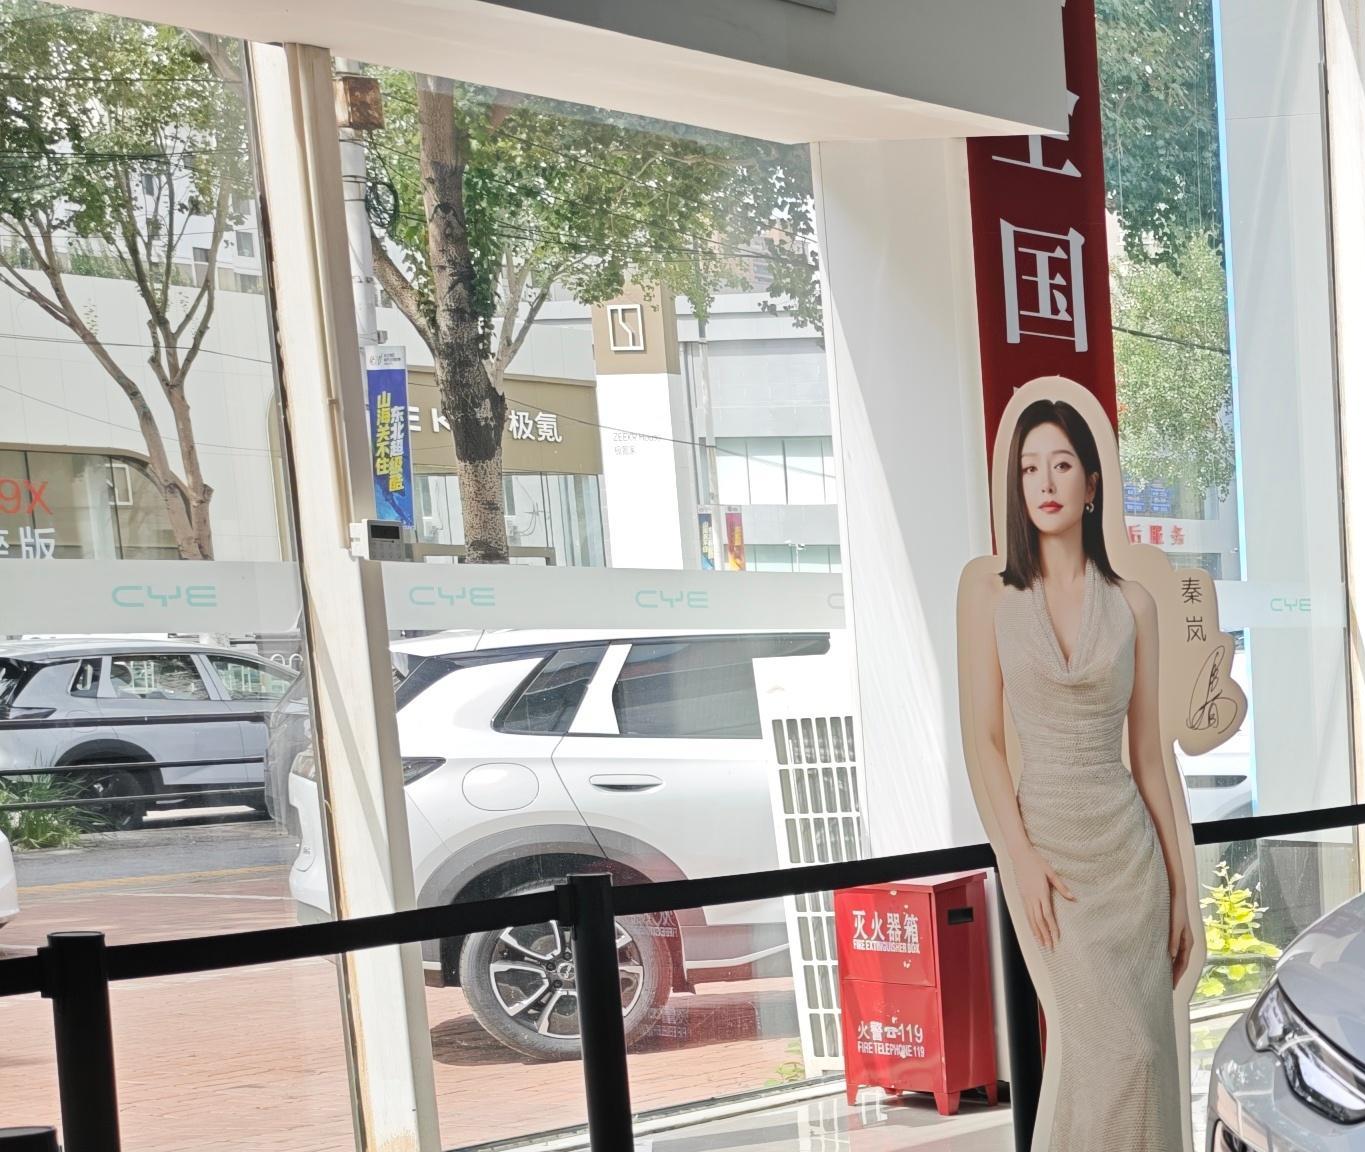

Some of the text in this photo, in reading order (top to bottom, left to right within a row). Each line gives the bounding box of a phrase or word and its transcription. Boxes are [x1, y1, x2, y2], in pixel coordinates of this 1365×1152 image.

[510, 411, 562, 443] 极氪
[1181, 577, 1206, 642] 秦岚
[852, 910, 919, 944] 灭火器箱
[853, 939, 865, 950] FIRE
[857, 1041, 925, 1057] FIRE TELEPHONE 119
